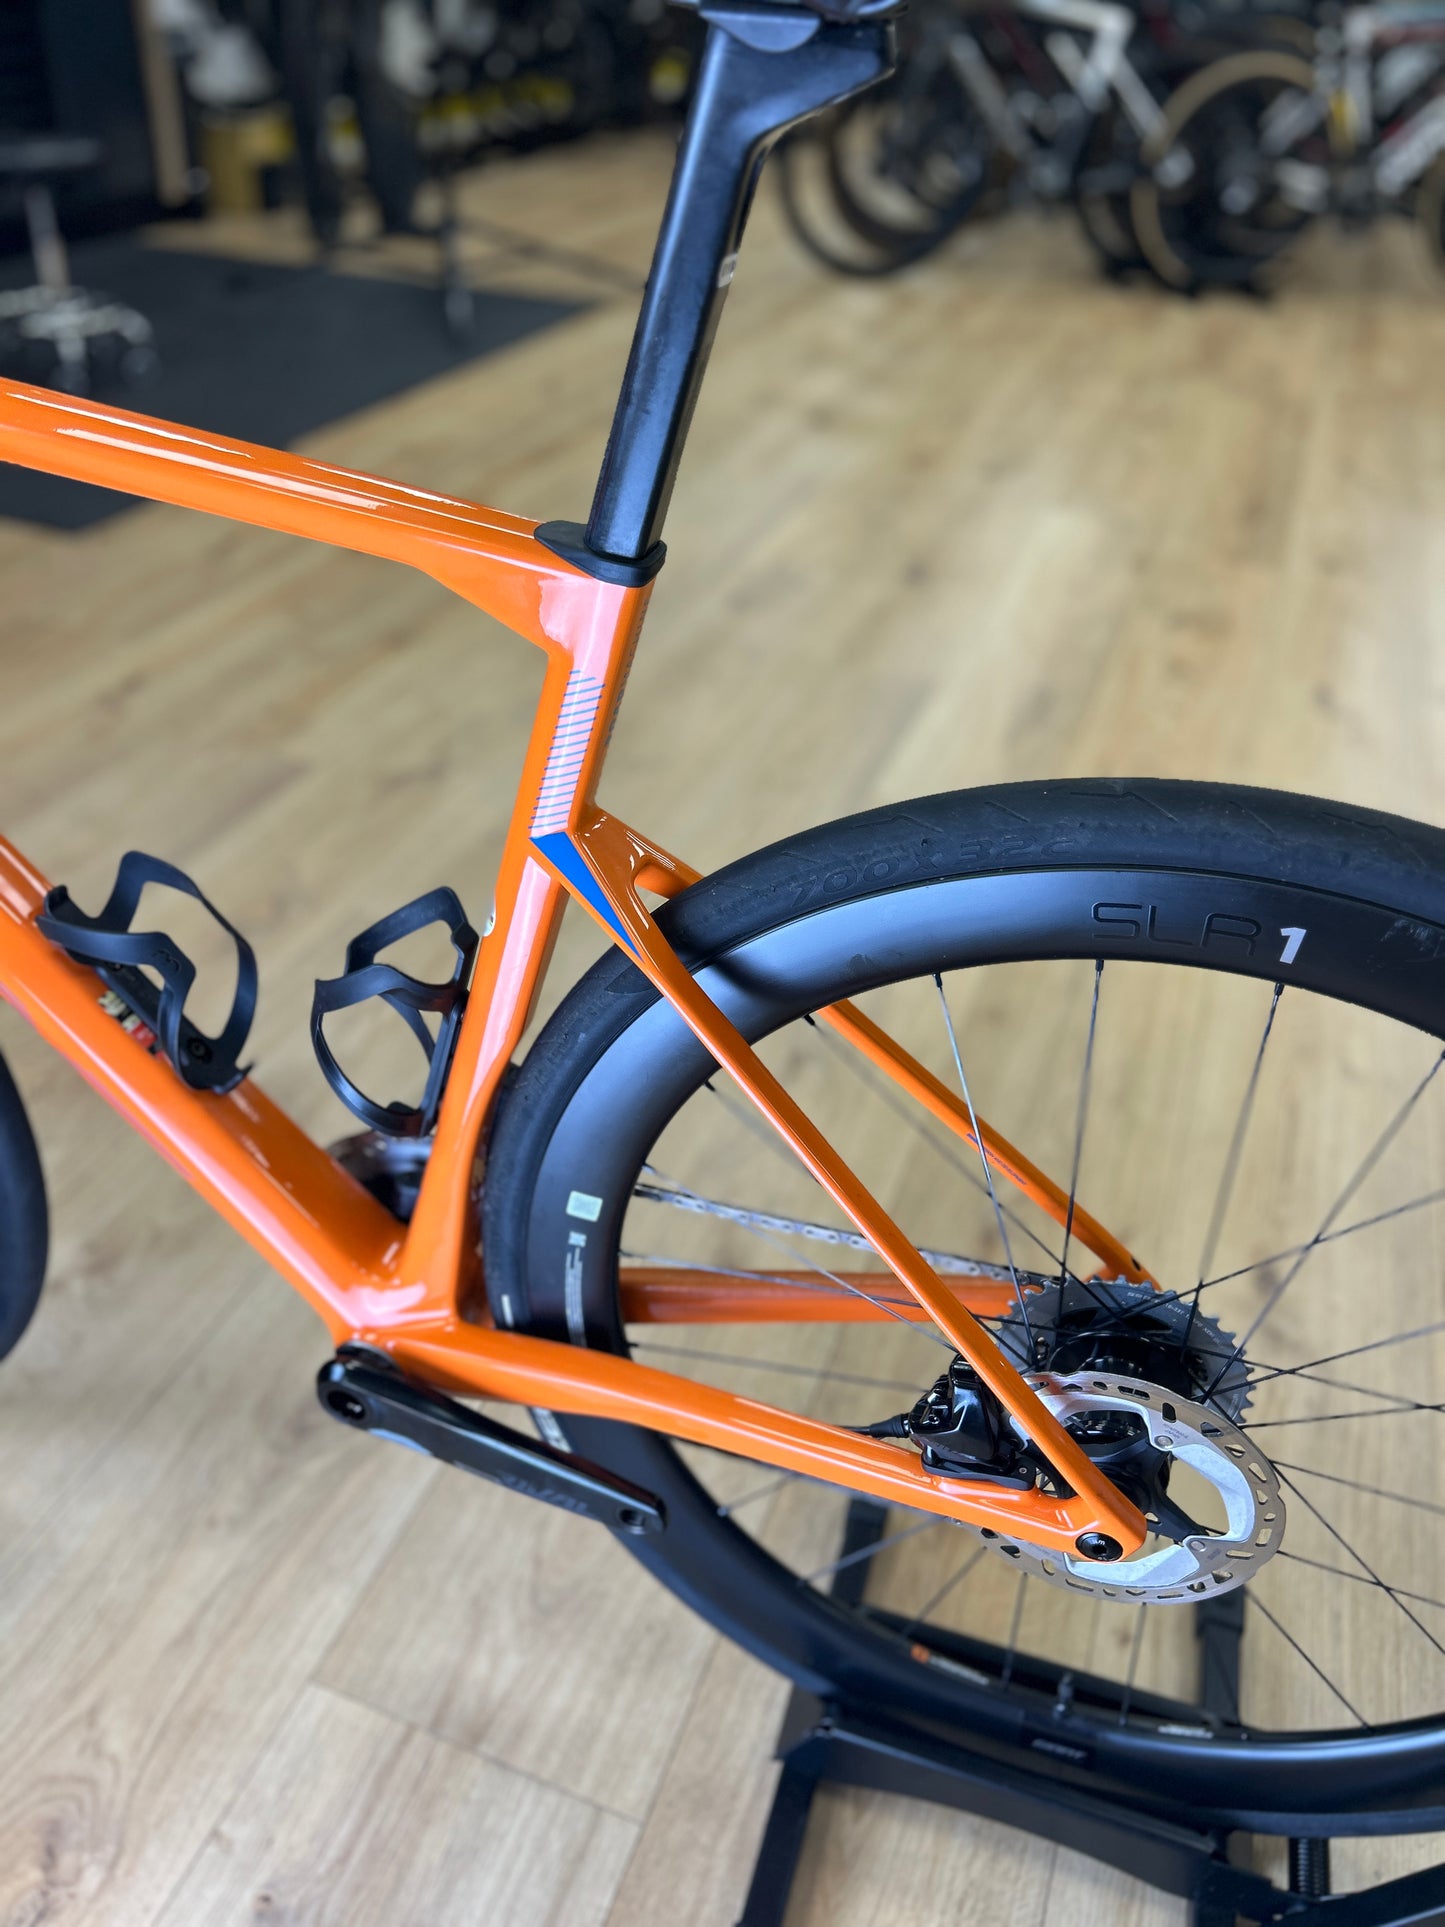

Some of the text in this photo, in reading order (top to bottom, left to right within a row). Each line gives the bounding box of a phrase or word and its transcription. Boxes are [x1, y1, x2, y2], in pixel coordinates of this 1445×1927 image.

[791, 857, 900, 907] 700
[1091, 901, 1307, 965] SLR 1
